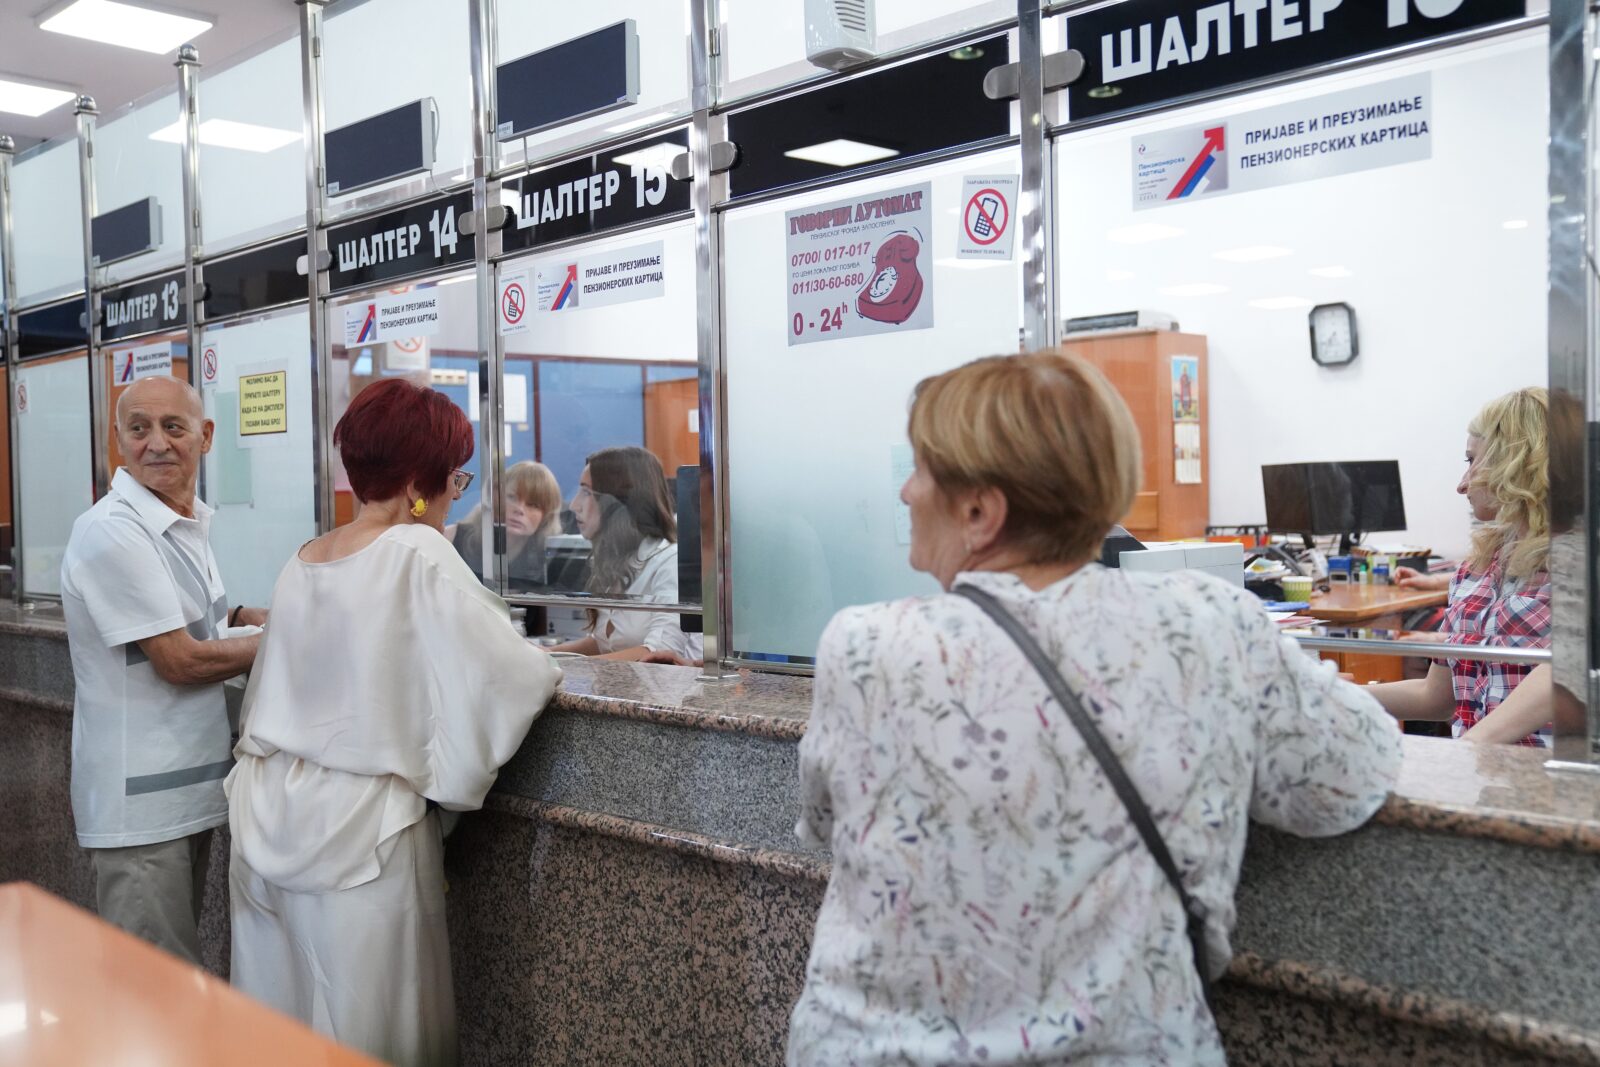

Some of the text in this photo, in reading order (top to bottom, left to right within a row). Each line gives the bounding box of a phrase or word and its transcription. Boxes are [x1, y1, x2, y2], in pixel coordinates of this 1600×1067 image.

[1245, 95, 1422, 145] ПРИЈАВЕ И ПРЕУЗИМАЊЕ
[1241, 120, 1429, 169] ПЕНЗИОНЕРСКИХ КАРТИЦА
[517, 164, 668, 230] ШАЛТЕР 15
[854, 191, 923, 222] АУТОМАТ
[338, 205, 458, 273] ШАЛТЕР 14
[824, 242, 871, 262] 017-017
[585, 255, 661, 279] ПРИЈАВЕ И ПРЕУЗИМАЊЕ
[583, 271, 665, 295] ПЕНЗИОНЕРСКИХ КАРТИЦА
[792, 272, 864, 295] 011/30-60-680
[106, 280, 179, 328] ШАЛТЕР 13
[382, 305, 401, 316] ПРИЈАВЕ
[417, 312, 438, 324] КАРТИЦА
[793, 312, 804, 336] 0
